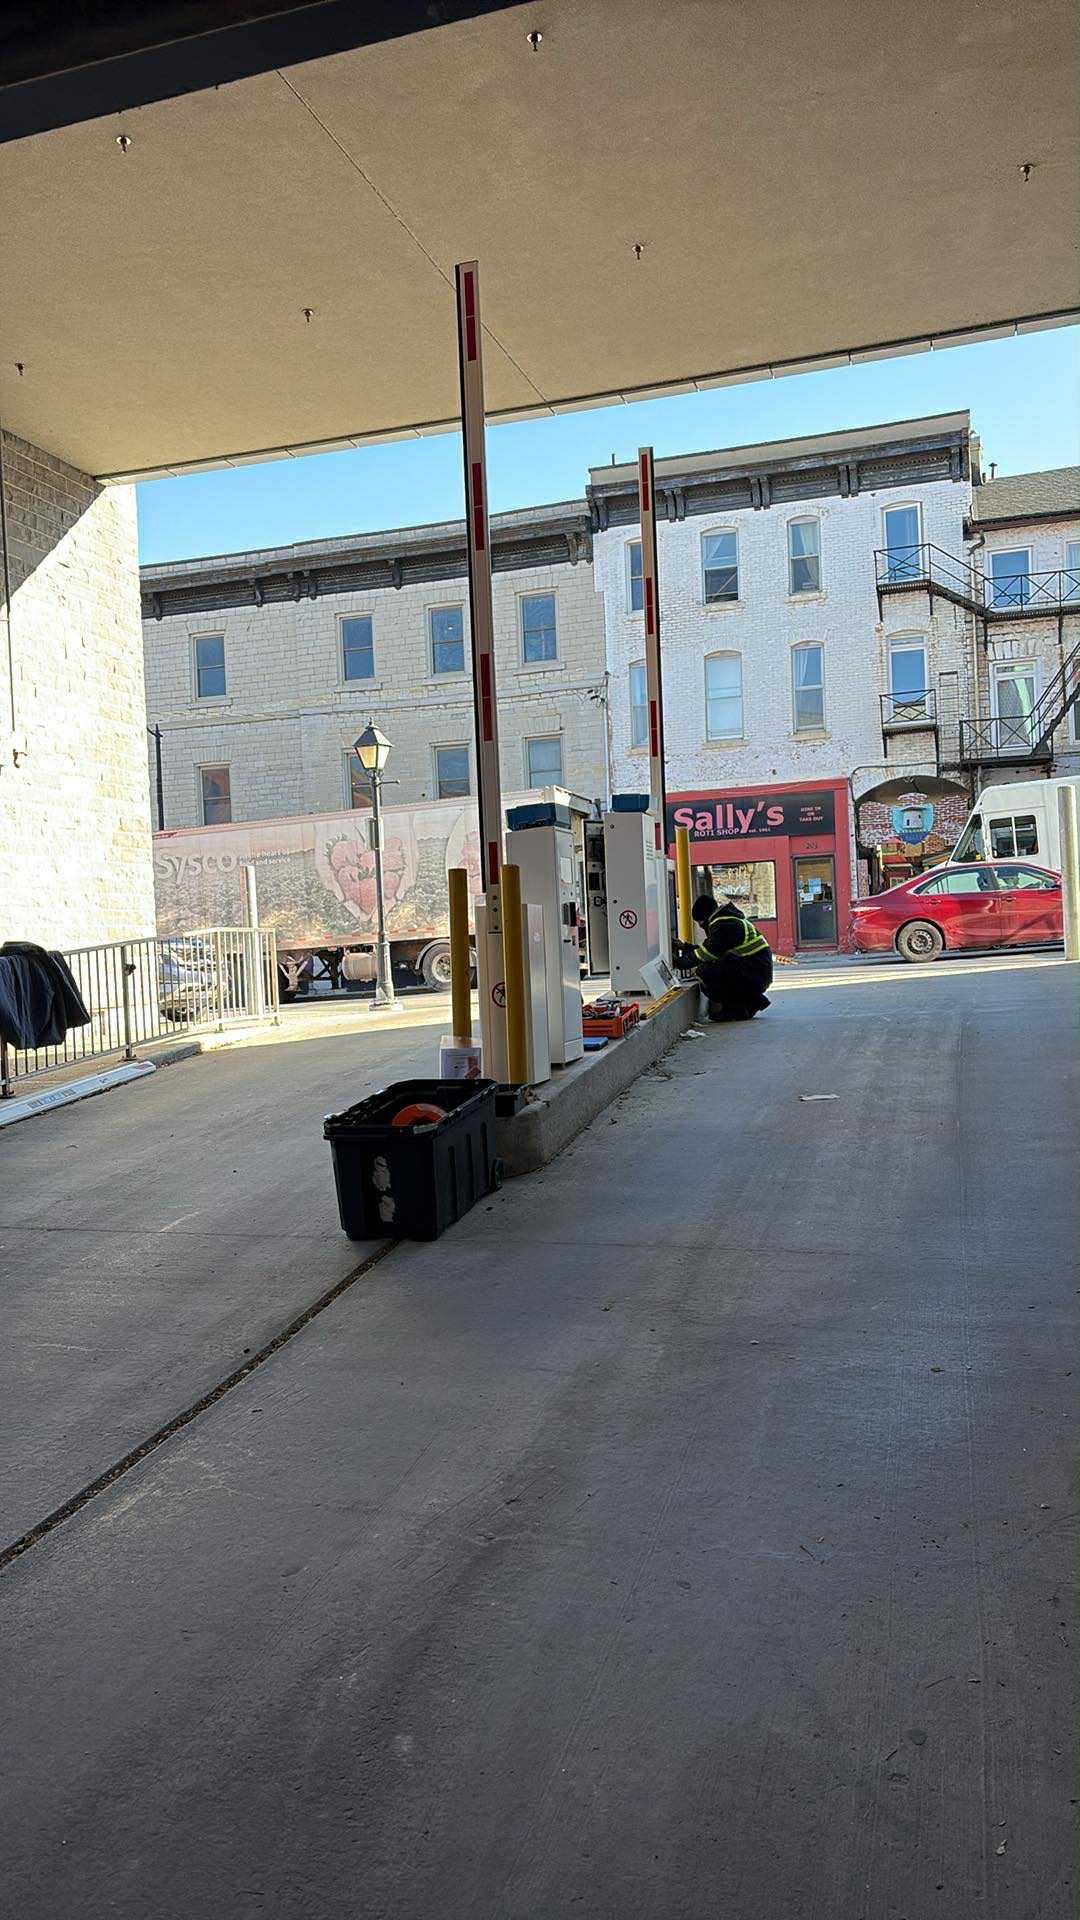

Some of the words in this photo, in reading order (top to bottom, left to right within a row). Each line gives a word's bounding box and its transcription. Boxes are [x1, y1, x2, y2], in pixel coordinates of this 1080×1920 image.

[673, 802, 785, 834] Sally's
[694, 829, 715, 838] ROTI
[716, 827, 740, 836] SHOP
